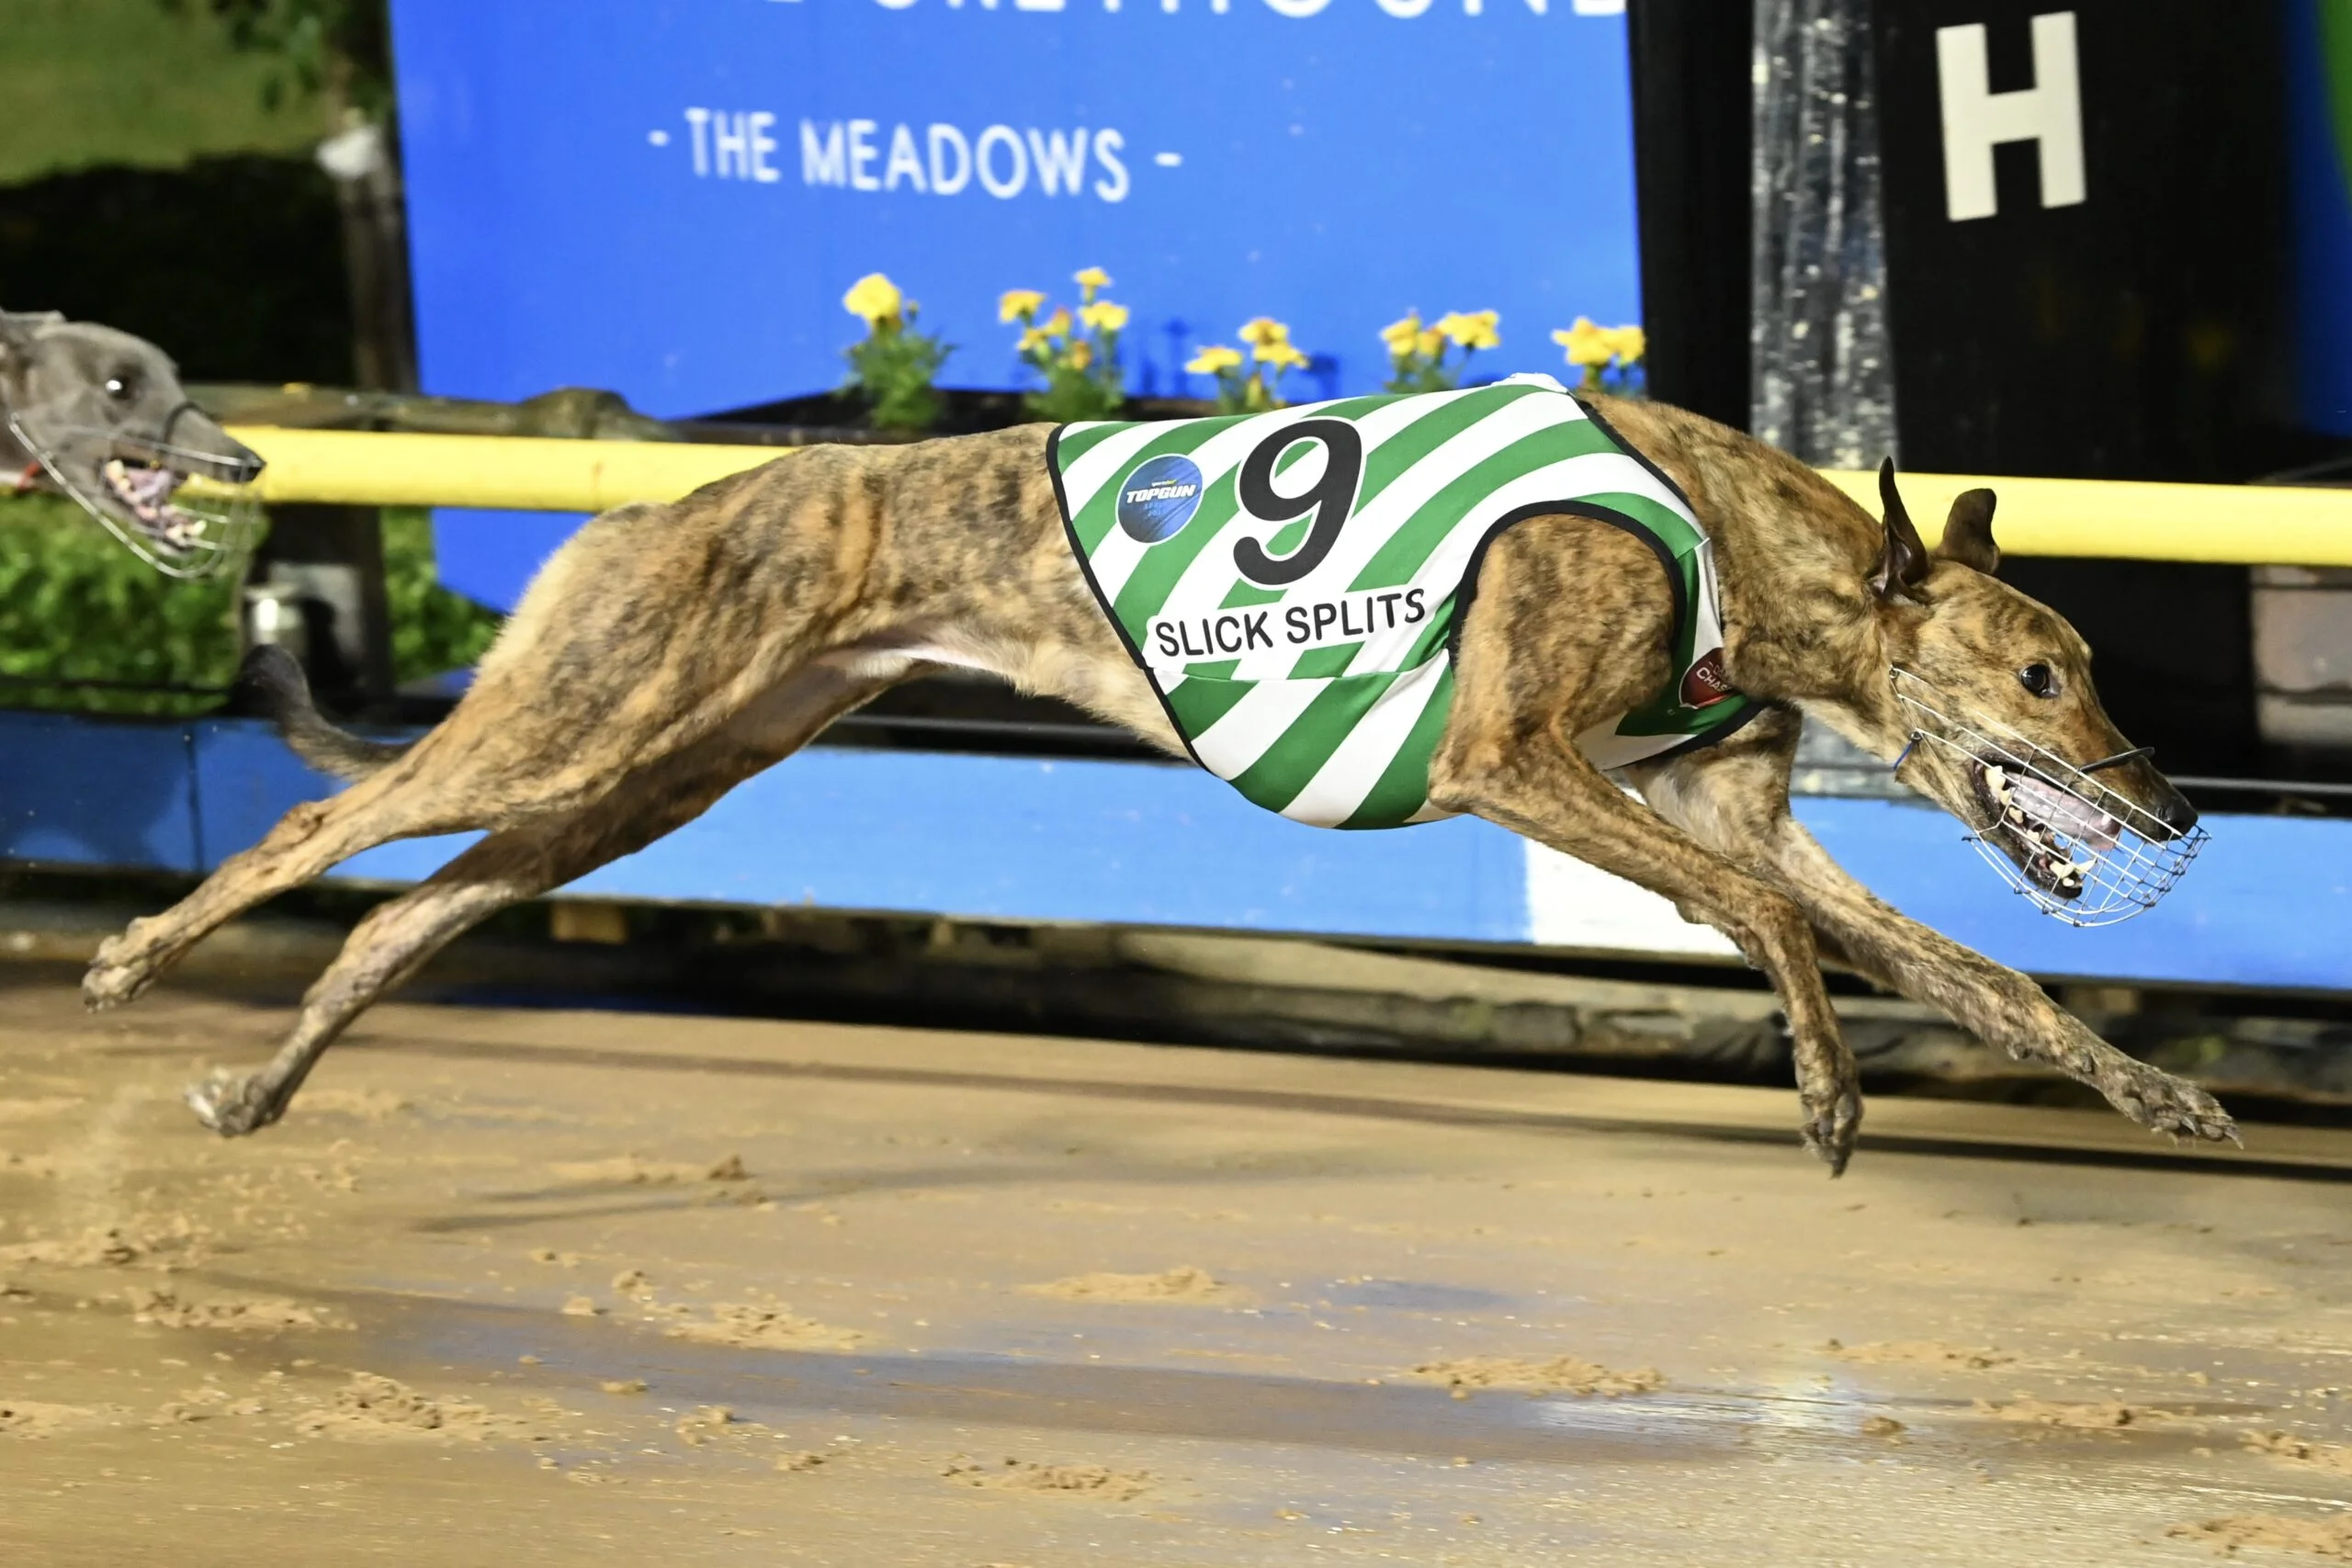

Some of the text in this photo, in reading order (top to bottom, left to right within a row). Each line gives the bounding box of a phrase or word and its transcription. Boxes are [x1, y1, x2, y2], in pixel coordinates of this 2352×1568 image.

[684, 106, 781, 184] THE
[798, 117, 1131, 203] MEADOWS
[1937, 11, 2086, 221] H
[1126, 484, 1196, 504] TOPGUN
[1233, 419, 1362, 586] 9
[1155, 588, 1426, 658] SLICK SPLITS
[1695, 667, 1731, 692] CHAS
